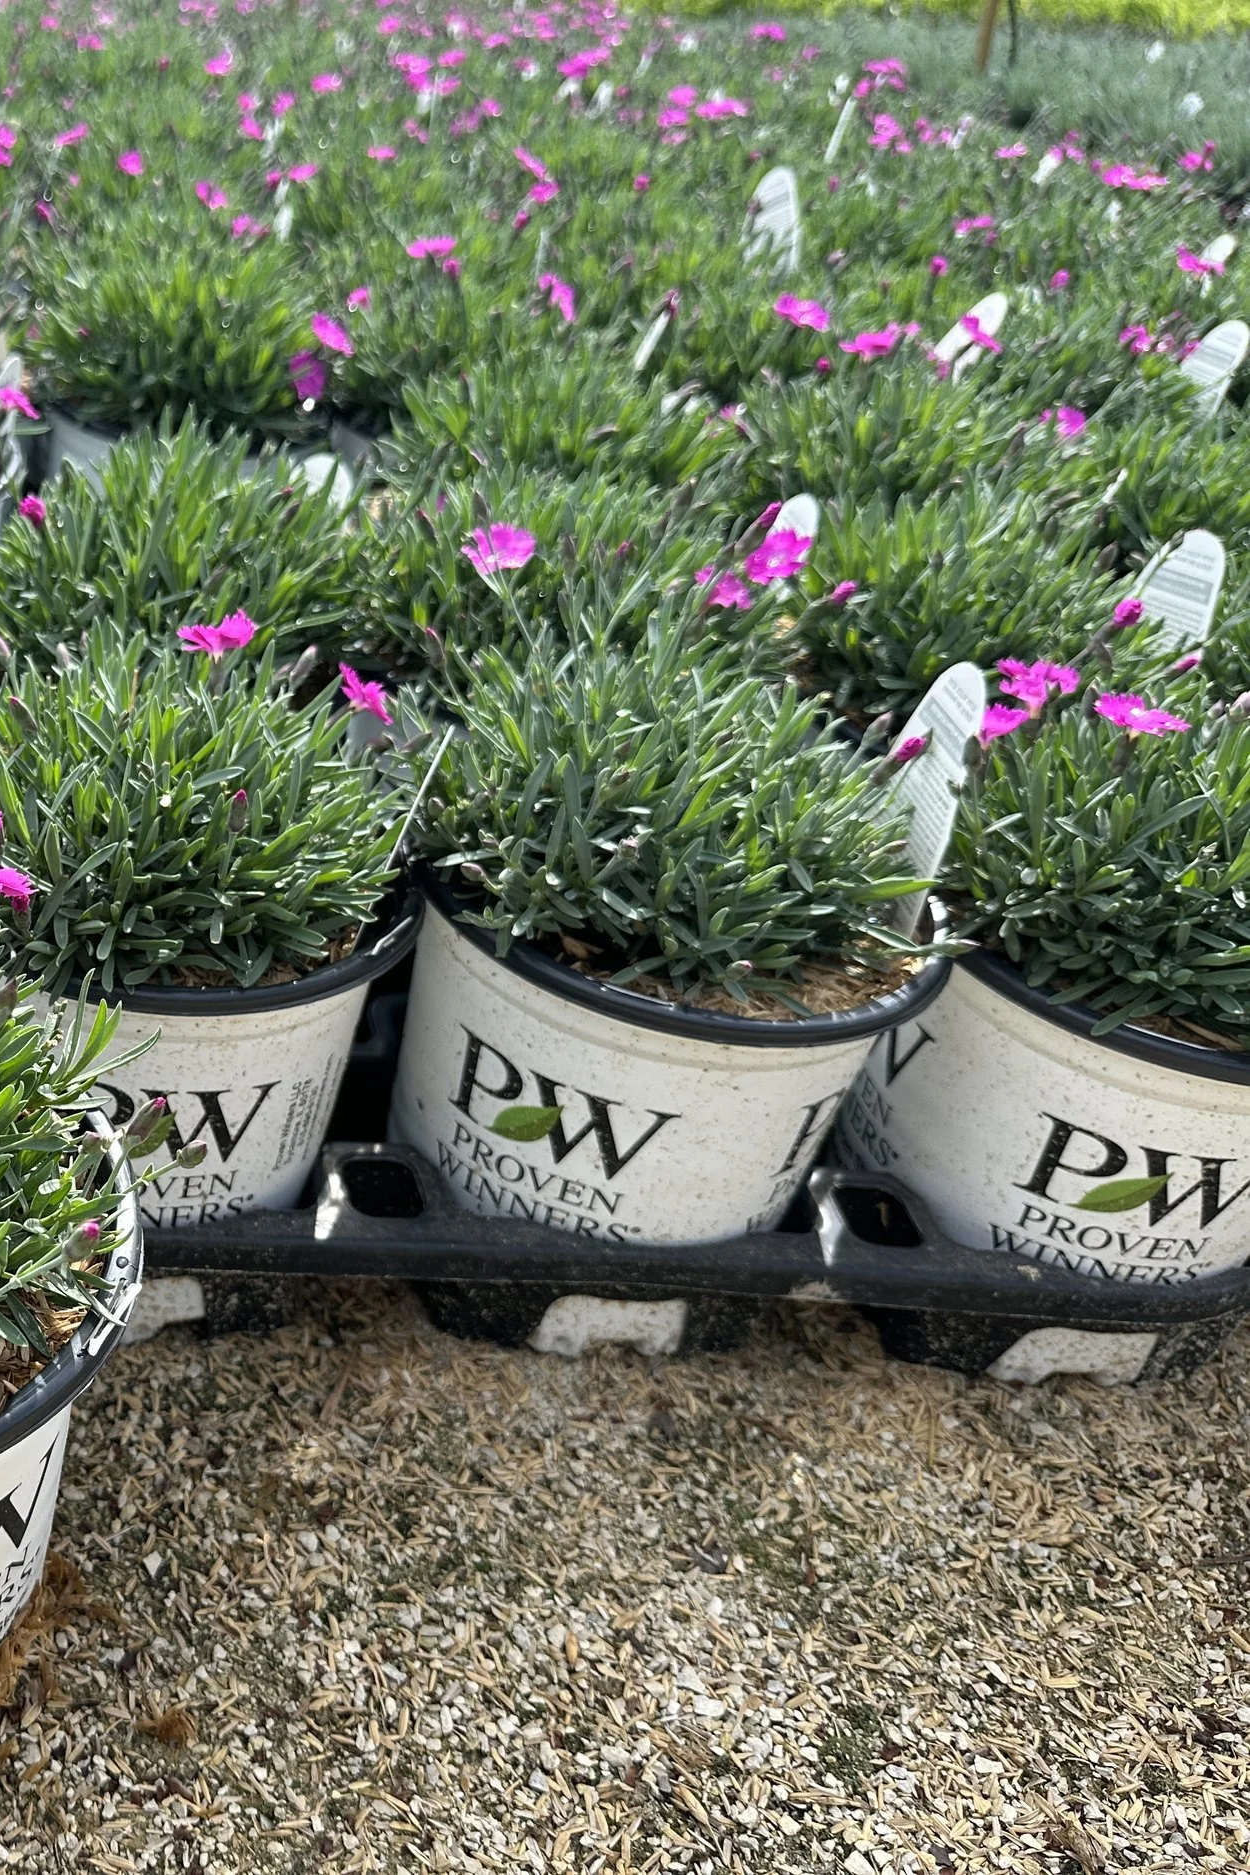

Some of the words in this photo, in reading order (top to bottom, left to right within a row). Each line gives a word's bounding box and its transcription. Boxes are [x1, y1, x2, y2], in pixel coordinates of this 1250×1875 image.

[447, 1023, 682, 1181] PW
[139, 1169, 239, 1199] VEN
[452, 1120, 626, 1216] PROVEN
[1011, 1110, 1250, 1230] PW
[139, 1193, 253, 1229] NERS
[1014, 1201, 1211, 1261] PROVEN
